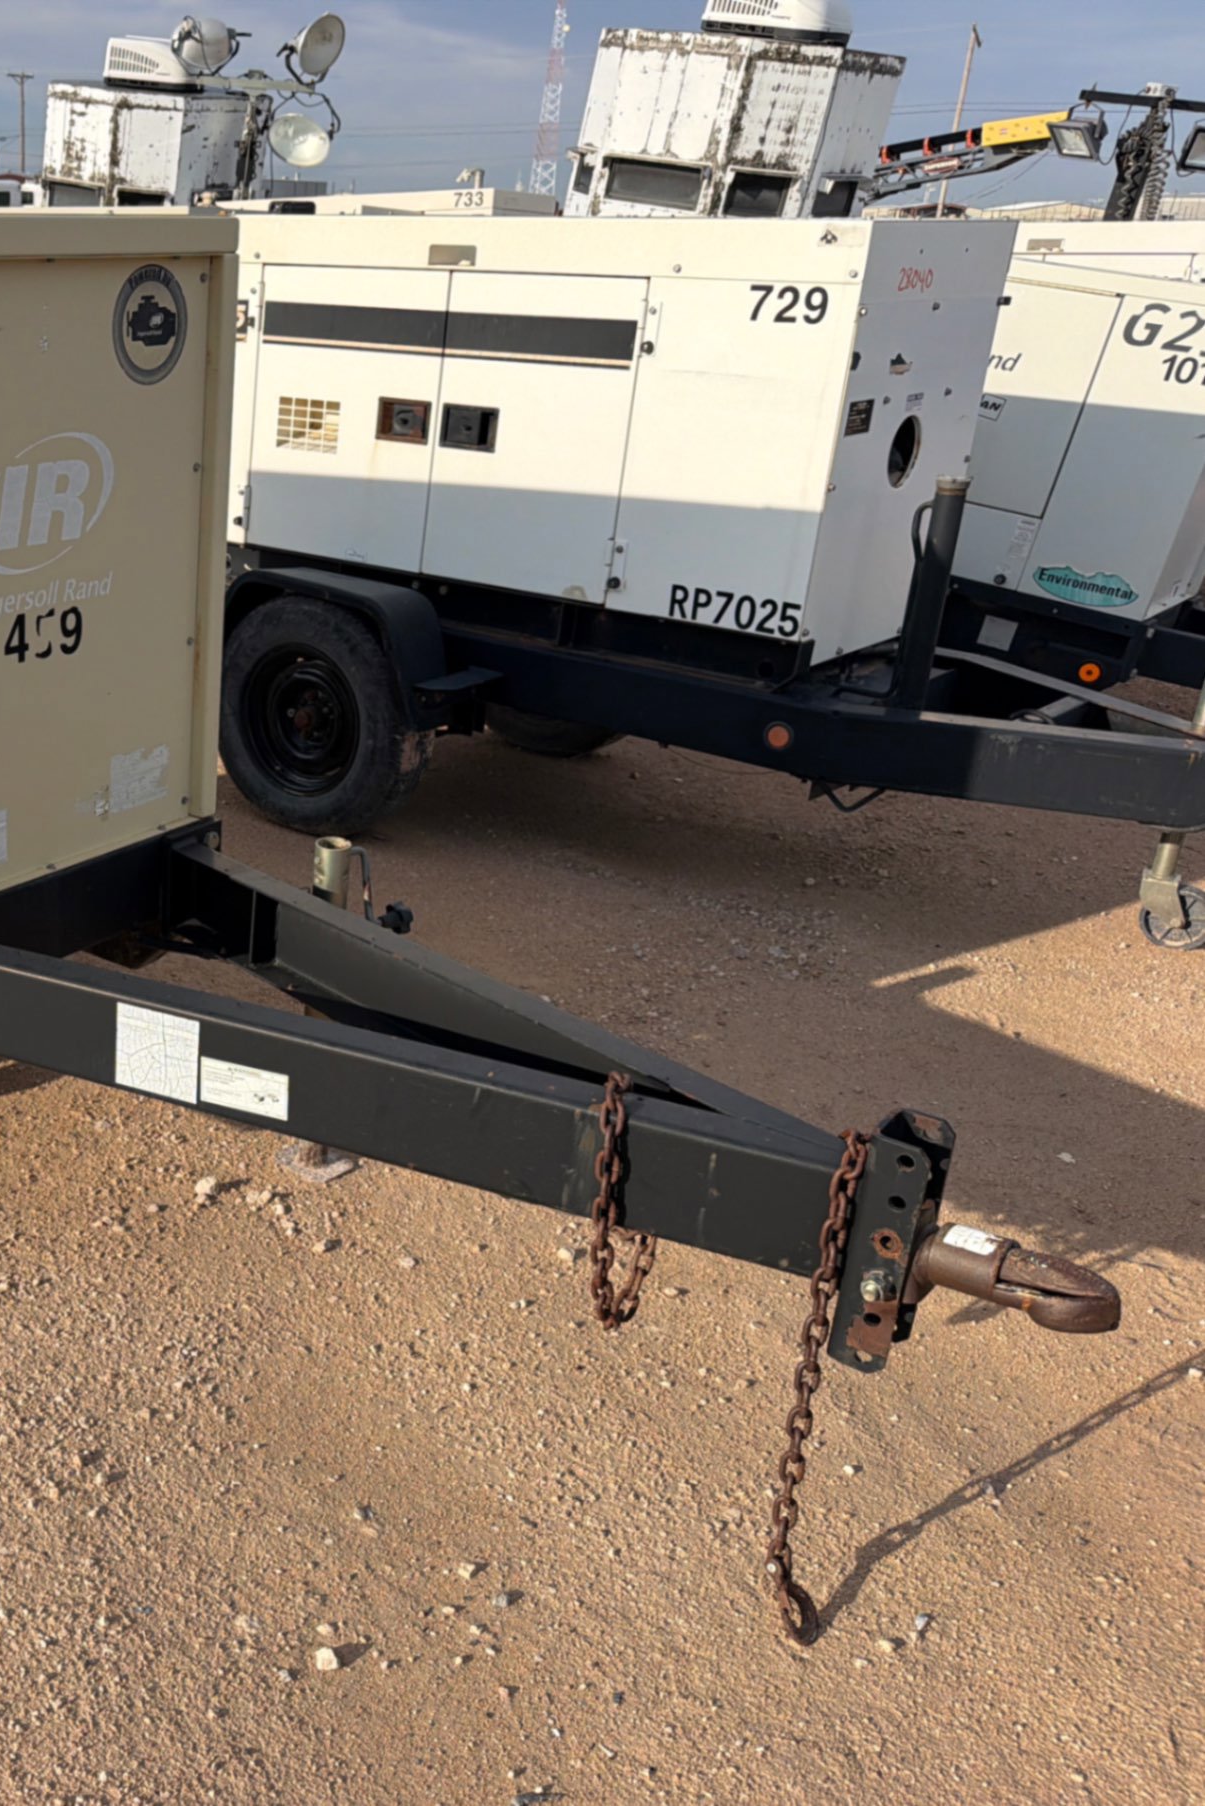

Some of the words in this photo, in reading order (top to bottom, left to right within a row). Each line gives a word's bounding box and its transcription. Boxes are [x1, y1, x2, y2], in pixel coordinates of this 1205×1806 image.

[453, 191, 484, 208] 733
[749, 284, 829, 325] 729
[1123, 303, 1205, 357] G2
[62, 571, 114, 602] Rand
[1038, 567, 1134, 601] Environmental
[668, 583, 802, 638] RP7025
